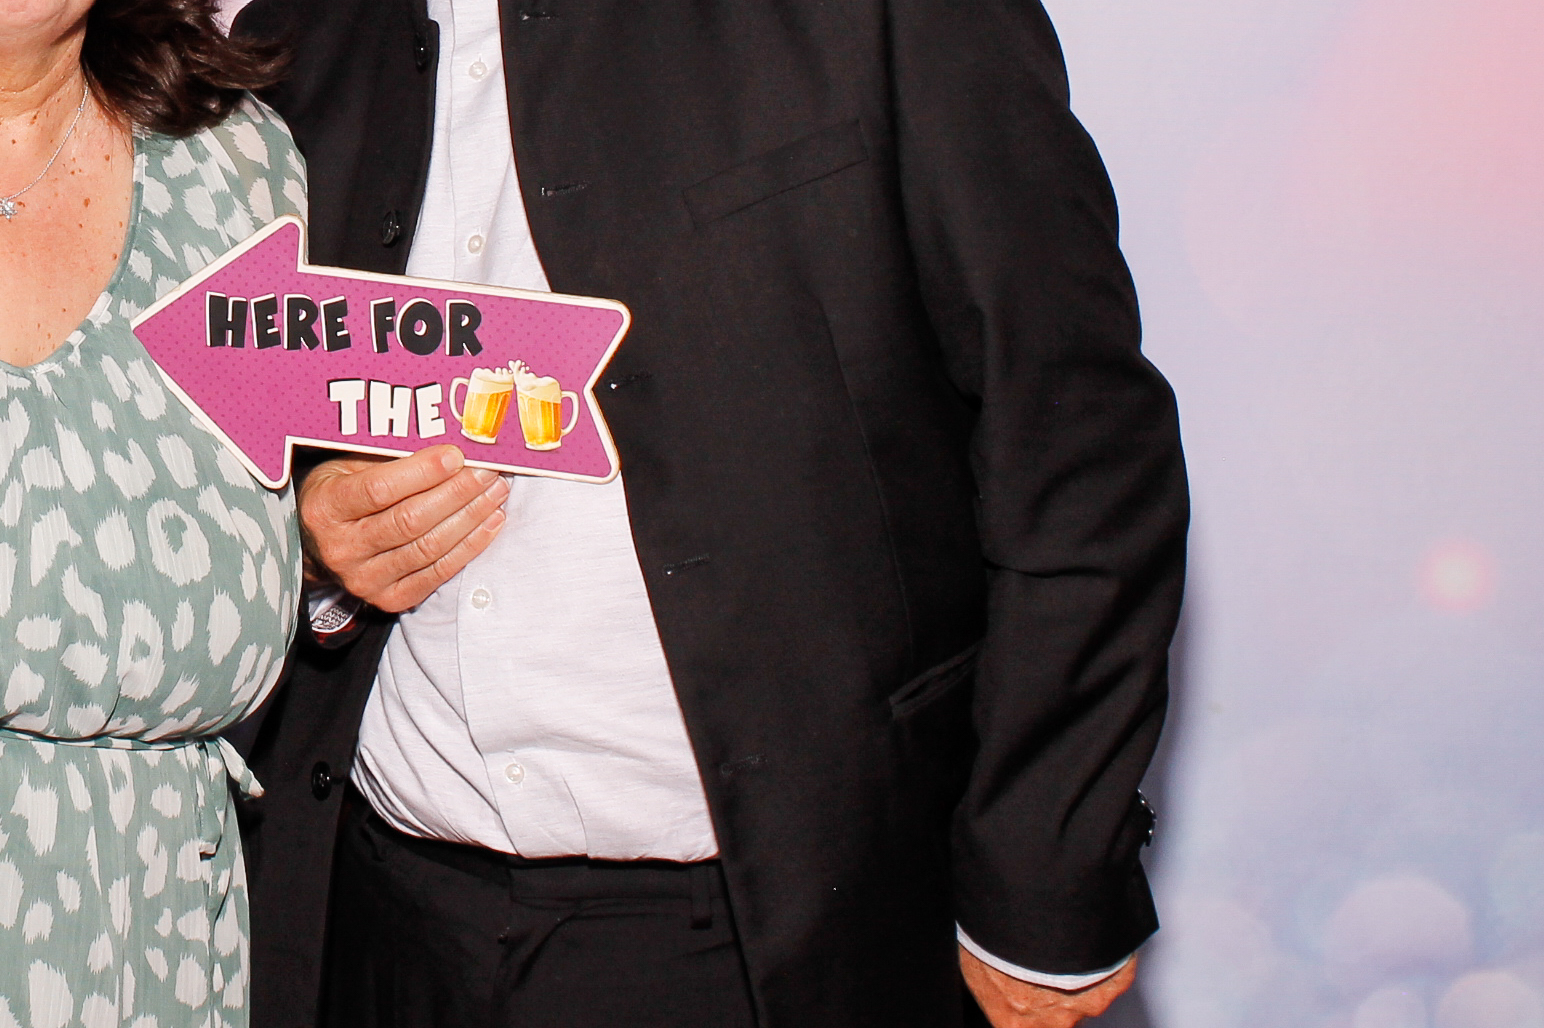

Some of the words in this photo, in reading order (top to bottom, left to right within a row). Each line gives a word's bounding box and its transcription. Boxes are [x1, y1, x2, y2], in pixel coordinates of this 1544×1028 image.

[205, 291, 351, 351] HERE
[370, 297, 483, 356] FOR
[327, 378, 446, 438] THE
